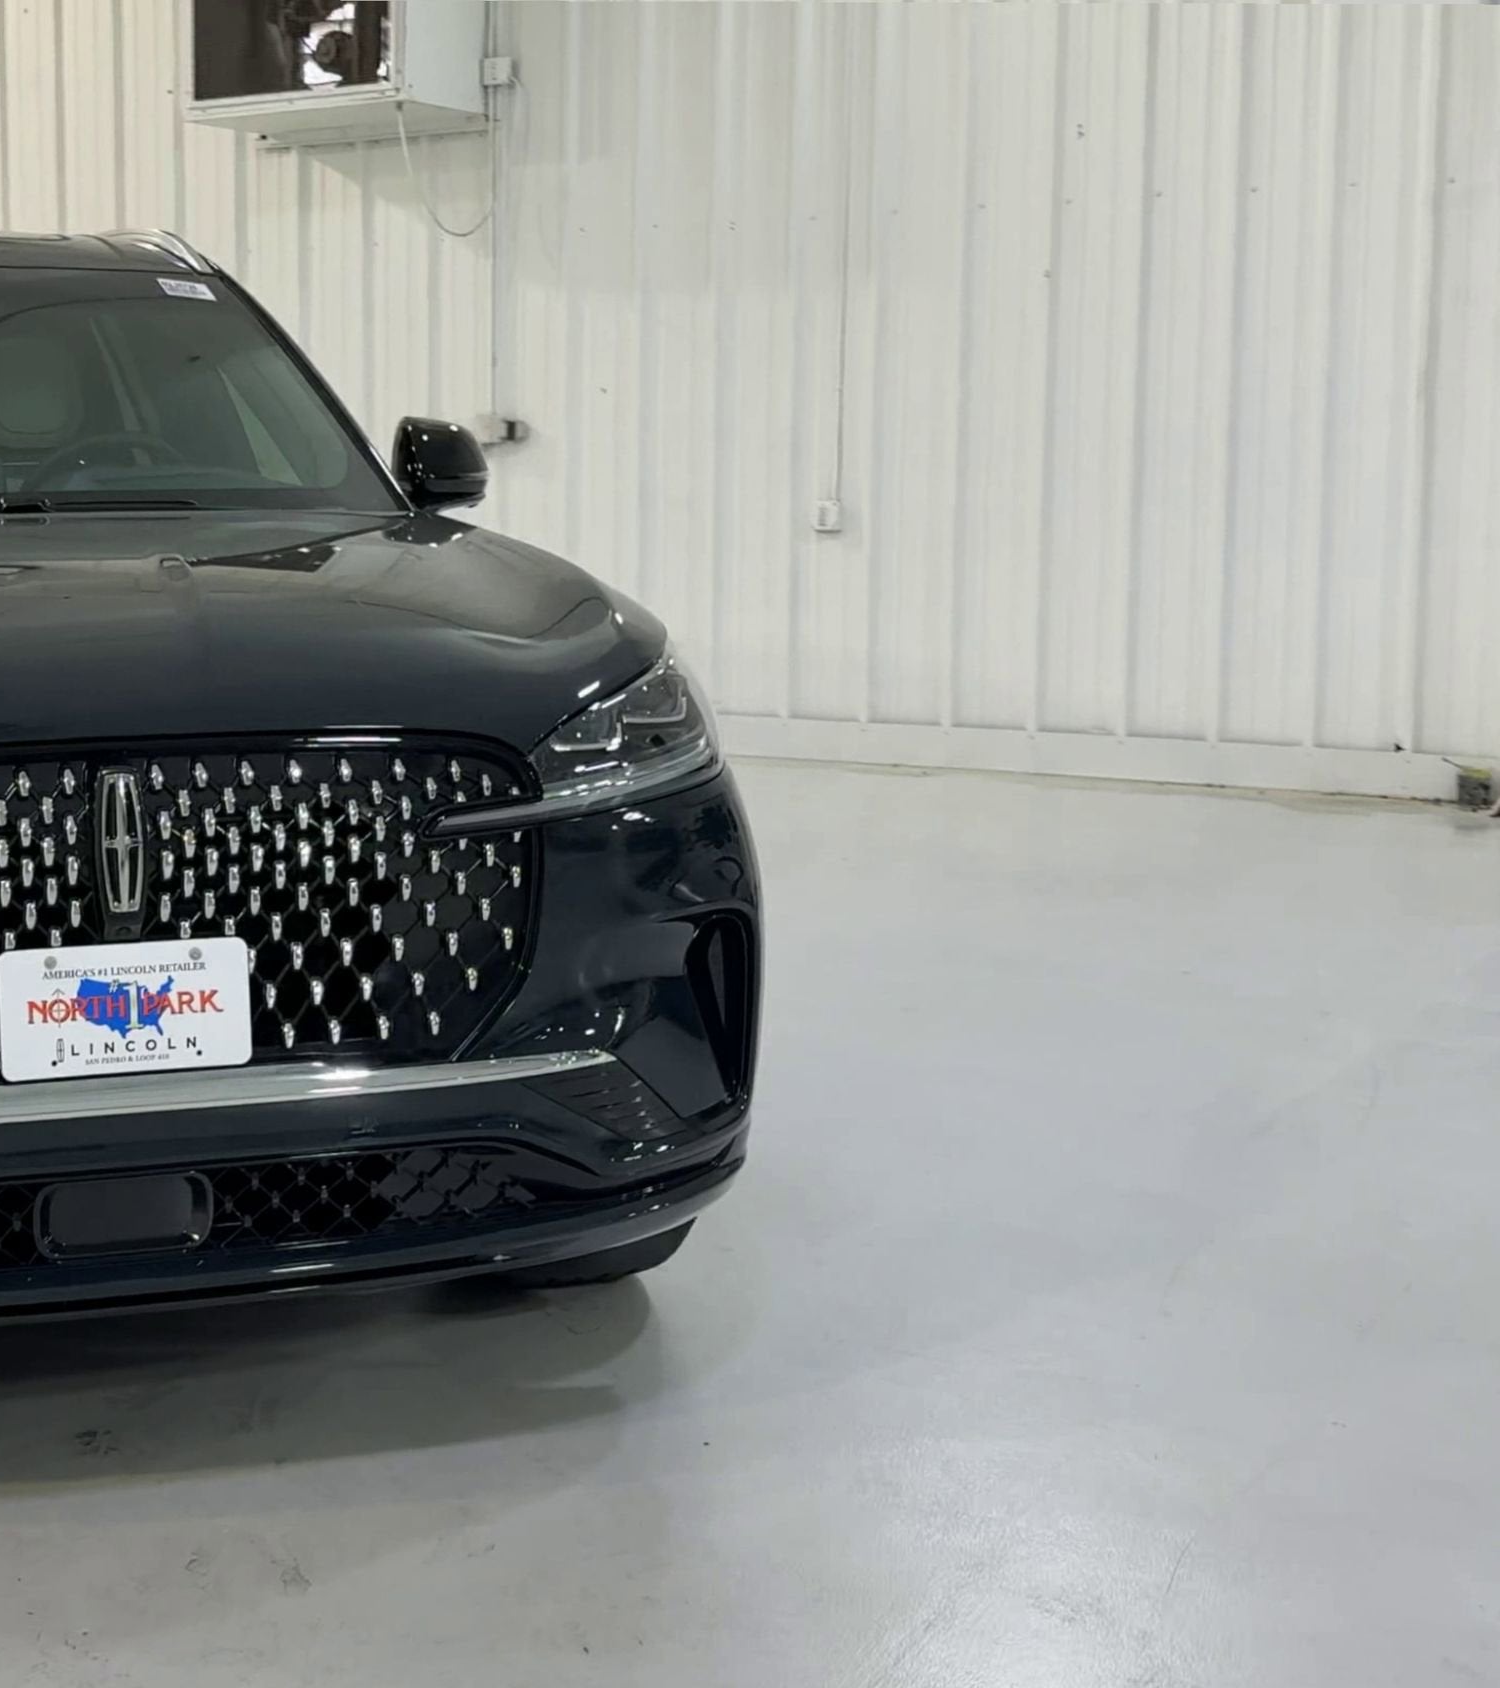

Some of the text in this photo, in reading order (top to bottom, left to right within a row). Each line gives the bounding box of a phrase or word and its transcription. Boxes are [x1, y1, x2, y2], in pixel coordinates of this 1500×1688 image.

[42, 961, 207, 980] AMERICA'S #1 LINCOLN RETAILER
[26, 989, 224, 1025] NORTH PARK
[71, 1036, 198, 1057] LINCOLN
[85, 1058, 100, 1066] SAN
[101, 1056, 127, 1064] PEDRO
[135, 1054, 156, 1062] LOOP
